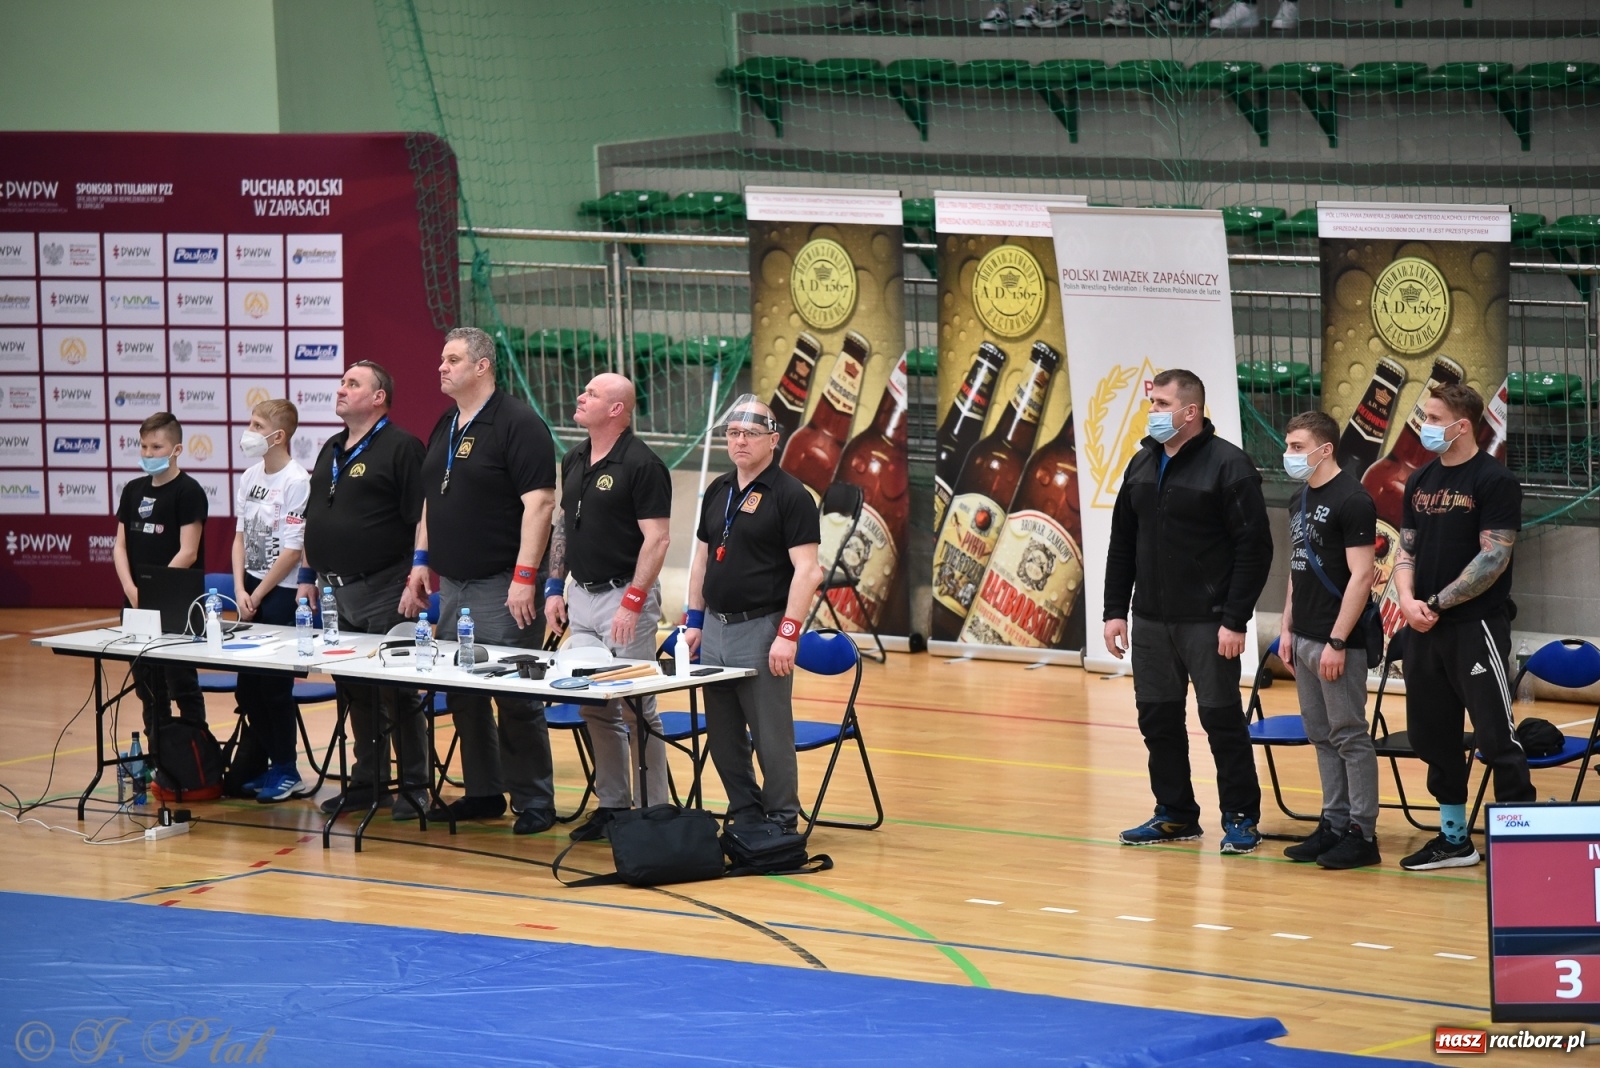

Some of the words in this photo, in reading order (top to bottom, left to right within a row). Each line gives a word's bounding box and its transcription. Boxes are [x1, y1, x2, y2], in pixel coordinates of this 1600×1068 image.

[6, 181, 58, 200] PWPW
[76, 183, 112, 195] SPONSOR
[114, 183, 158, 195] TYTULARNY
[159, 183, 173, 196] PZZ
[241, 179, 295, 196] PUCHAR
[297, 178, 342, 196] POLSKI
[254, 199, 267, 216] W
[269, 199, 330, 216] ZAPASACH
[1062, 269, 1099, 282] POLSKI
[1103, 270, 1150, 285] ZWIĄZEK
[1153, 270, 1219, 286] ZAPAŚNICZY
[1012, 287, 1037, 306] 1567
[1081, 284, 1107, 292] Wrestling
[58, 294, 89, 304] PWPW
[1413, 300, 1441, 321] 1567
[61, 389, 91, 399] PWPW
[66, 485, 96, 495] PWPW
[1314, 505, 1330, 523] 52
[20, 534, 72, 552] PWPW
[1555, 959, 1583, 999] 3
